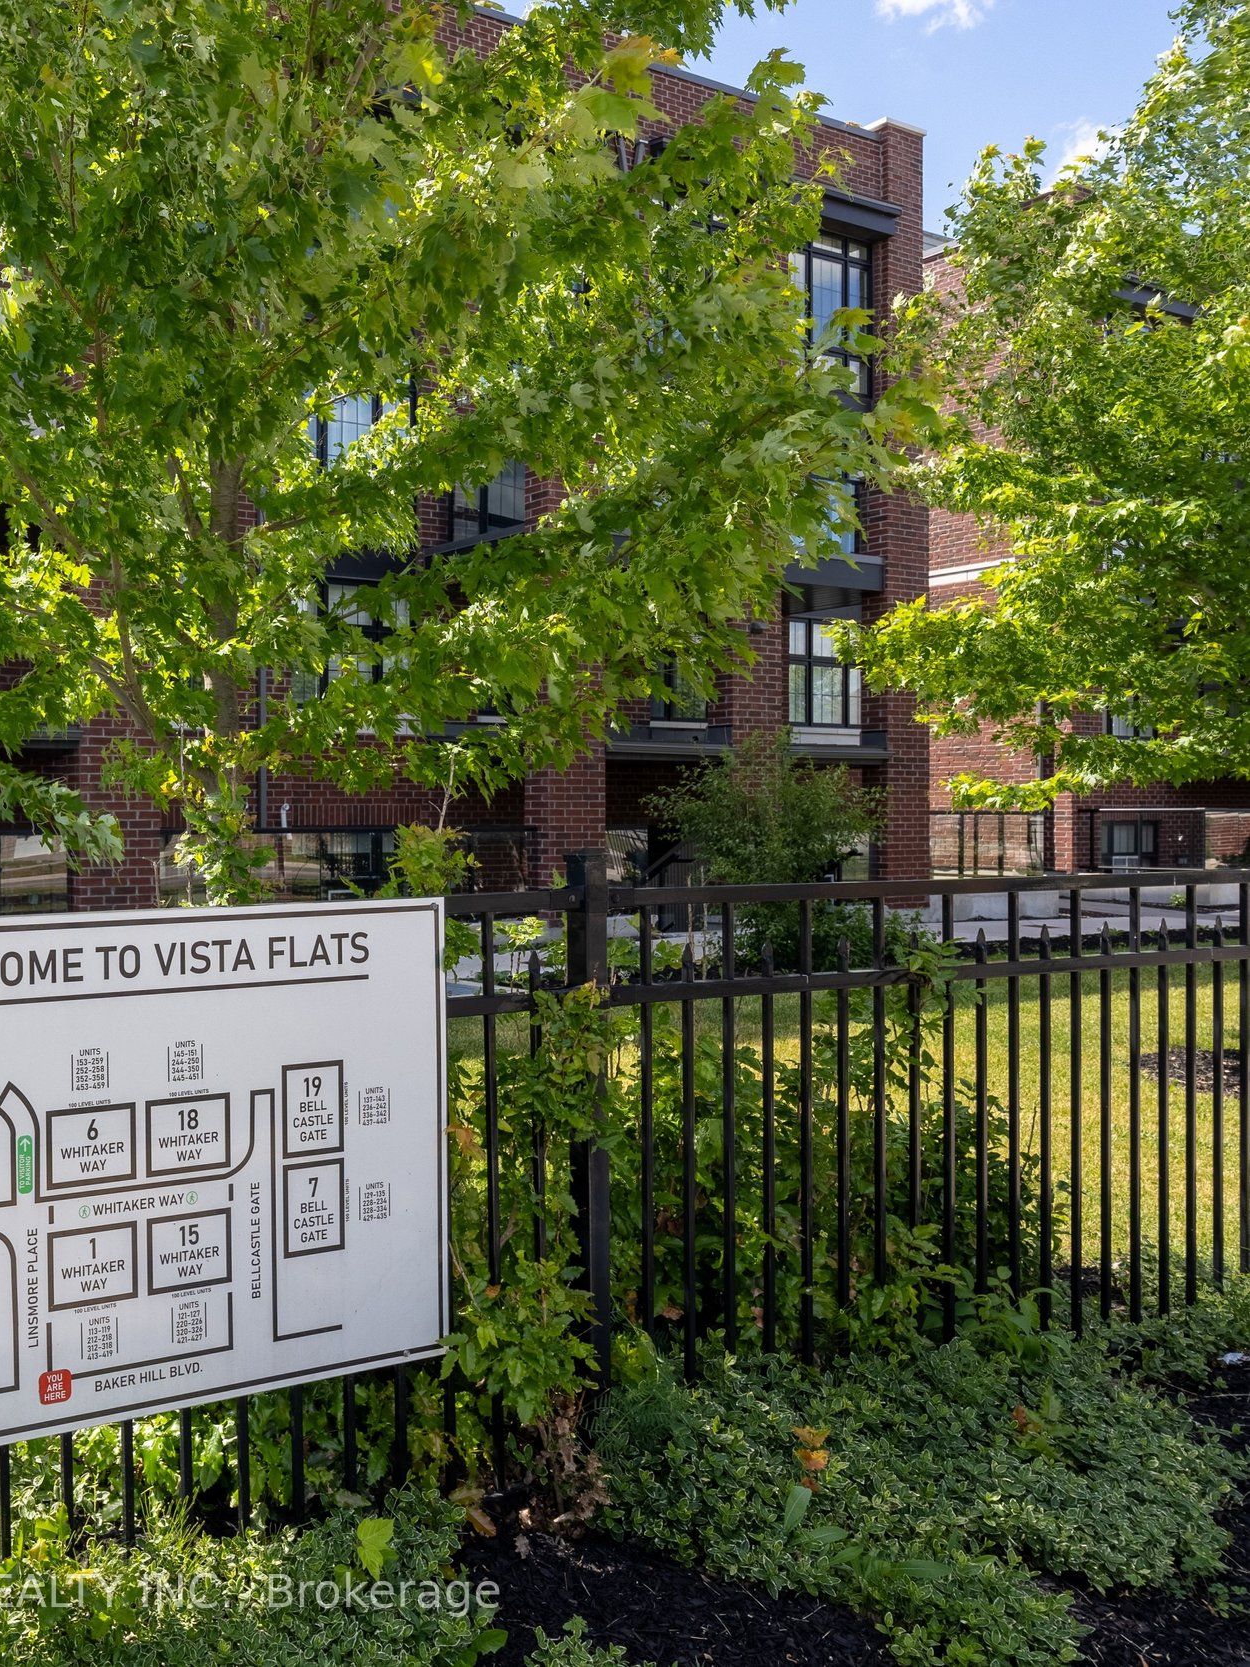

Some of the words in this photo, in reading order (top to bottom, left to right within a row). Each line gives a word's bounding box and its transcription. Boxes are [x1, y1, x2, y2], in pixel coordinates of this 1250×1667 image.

[95, 945, 141, 980] TO
[154, 938, 255, 976] VISTA
[268, 932, 369, 970] FLATS
[175, 1040, 195, 1048] UNITS
[80, 1048, 100, 1056] UNITS
[174, 1049, 197, 1058] 145-151
[76, 1058, 104, 1066] 153-259
[172, 1057, 199, 1066] 244-250
[76, 1066, 104, 1074] 252-258
[172, 1065, 200, 1074] 344-350
[76, 1074, 104, 1082] 352-358
[172, 1073, 199, 1082] 445-451
[76, 1082, 105, 1091] 453-459
[304, 1076, 322, 1097] 19
[300, 1100, 327, 1112] BELL
[178, 1109, 198, 1131] 18
[293, 1114, 334, 1128] CASTLE
[87, 1119, 98, 1140] 6
[158, 1132, 218, 1148] WHITAKER
[300, 1129, 327, 1142] GATE
[61, 1142, 124, 1160] WHITAKER
[177, 1149, 202, 1162] WAY
[80, 1159, 107, 1173] WAY
[309, 1177, 318, 1197] 7
[366, 1182, 383, 1190] UNITS
[251, 1182, 260, 1214] GATE
[364, 1190, 385, 1199] 129-135
[93, 1198, 155, 1216] WHITAKER
[159, 1193, 184, 1206] WAY
[300, 1200, 327, 1213] BELL
[362, 1198, 387, 1207] 228-234
[362, 1206, 387, 1214] 328-334
[294, 1214, 334, 1229] CASTLE
[363, 1213, 387, 1222] 429-435
[179, 1224, 199, 1246] 15
[301, 1229, 327, 1243] GATE
[28, 1228, 38, 1273] PLACE
[89, 1238, 96, 1259] 1
[160, 1246, 219, 1265] WHITAKER
[251, 1218, 261, 1298] BELLCASTLE
[61, 1260, 125, 1280] WHITAKER
[178, 1264, 203, 1278] WAY
[81, 1278, 107, 1292] WAY
[179, 1301, 199, 1310] UNITS
[28, 1276, 39, 1348] LINSMORE
[178, 1310, 200, 1319] 121-127
[89, 1316, 110, 1326] UNITS
[176, 1319, 202, 1328] 220-226
[88, 1326, 110, 1335] 113-119
[176, 1327, 203, 1336] 320-326
[87, 1334, 112, 1344] 212-218
[177, 1334, 202, 1344] 421-427
[87, 1342, 112, 1352] 312-318
[87, 1350, 113, 1360] 413-419
[46, 1374, 62, 1382] YOU
[95, 1375, 136, 1392] BAKER
[140, 1370, 166, 1384] HILL
[170, 1362, 203, 1378] BLVD.
[46, 1383, 63, 1391] ARE
[44, 1392, 66, 1402] HERE
